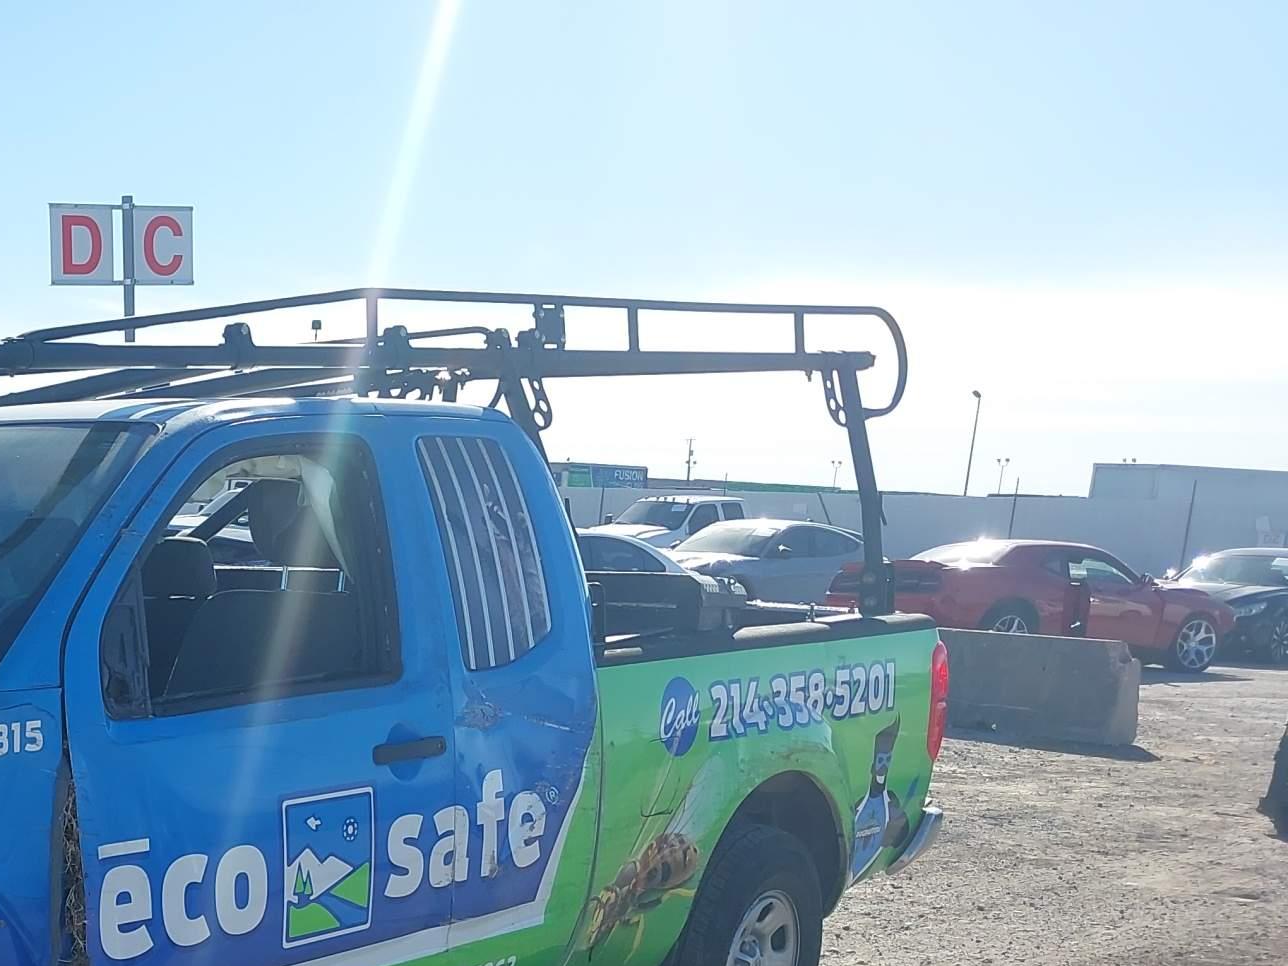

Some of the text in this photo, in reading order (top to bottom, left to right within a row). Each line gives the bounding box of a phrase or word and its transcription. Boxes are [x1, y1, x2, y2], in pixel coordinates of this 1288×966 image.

[62, 215, 102, 275] D
[144, 215, 183, 276] C
[614, 469, 645, 482] FUSION
[660, 692, 700, 742] Call
